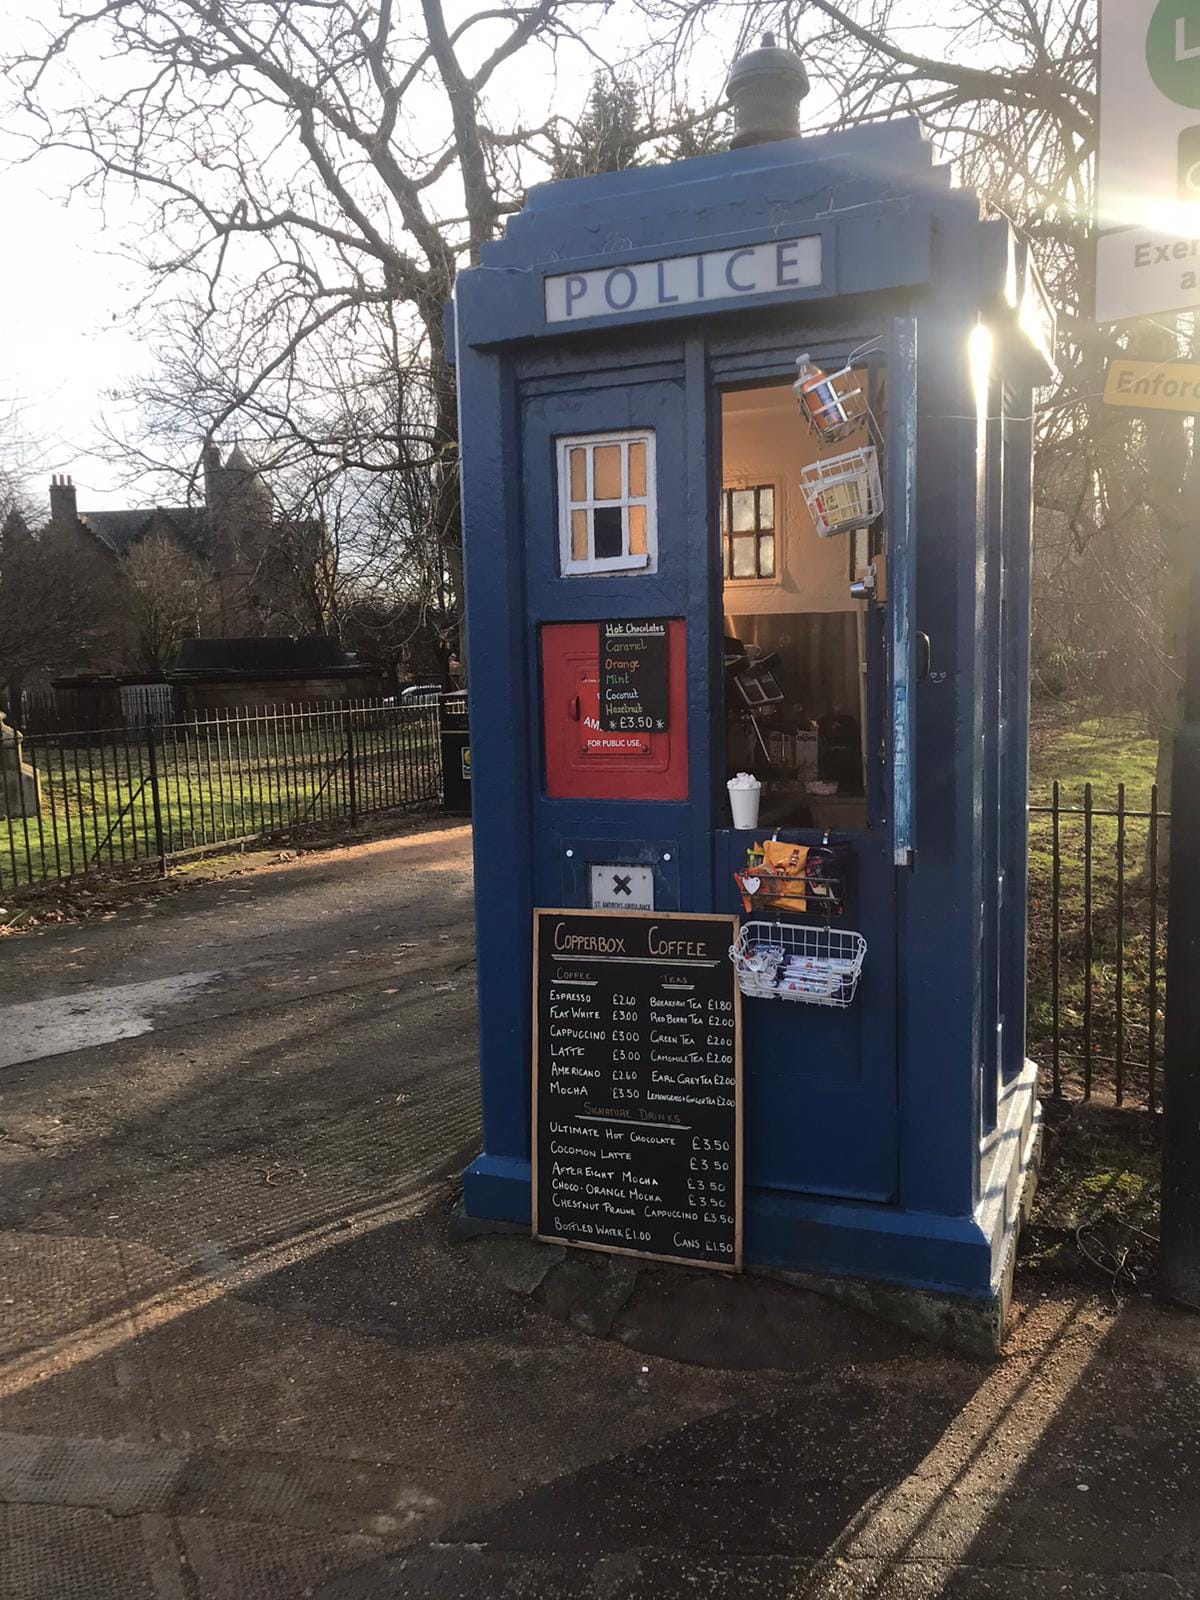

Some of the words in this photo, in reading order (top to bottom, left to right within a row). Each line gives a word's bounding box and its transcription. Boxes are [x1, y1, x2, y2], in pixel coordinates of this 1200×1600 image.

[1134, 239, 1200, 268] Exe
[565, 242, 800, 317] POLICE
[605, 623, 624, 634] Hot
[625, 623, 665, 633] Chocolates
[605, 639, 647, 652] Caramel
[605, 658, 640, 673] Orange
[606, 672, 630, 685] Mint
[605, 688, 639, 701] Coconut
[605, 703, 643, 715] Hazelnut
[620, 716, 653, 729] £3.50
[554, 922, 626, 953] COPPERBOX
[648, 926, 707, 957] COFFEE
[556, 967, 592, 980] COFFEE
[661, 975, 688, 984] TEAS
[550, 990, 591, 1003] ESPRESSO
[687, 998, 702, 1009] TEA
[550, 1005, 570, 1019] FLAT
[571, 1007, 600, 1019] WHITE
[688, 1013, 704, 1025] TEA
[550, 1024, 606, 1041] CAPPUCCINO
[650, 1030, 678, 1044] GREEN
[680, 1034, 696, 1045] TEA
[550, 1044, 585, 1057] LATTE
[688, 1052, 704, 1063] TEA
[551, 1062, 601, 1078] AMERICANO
[651, 1070, 676, 1083] EARL
[677, 1073, 700, 1086] GREY
[700, 1075, 713, 1085] TEA
[550, 1081, 589, 1096] MOCHA
[583, 1102, 632, 1118] SIGNATURE
[638, 1108, 681, 1123] DRINKS
[549, 1121, 600, 1137] ULTIMATE
[605, 1128, 624, 1140] HOT
[630, 1131, 676, 1146] CHOCOLATE
[550, 1141, 597, 1157] COCOMON
[601, 1149, 632, 1160] LATTE
[552, 1161, 583, 1176] AFTER
[585, 1167, 615, 1179] EIGHT
[622, 1171, 659, 1186] MOCHA
[629, 1187, 663, 1202] MOCHA
[552, 1193, 600, 1211] CHESTNUT
[602, 1202, 636, 1216] PRALINE
[644, 1205, 699, 1221] CAPPUCCINO
[554, 1216, 594, 1234] BOTTLED
[595, 1224, 624, 1238] WATER
[673, 1232, 701, 1249] CANS
[705, 1241, 734, 1253] £1.50
